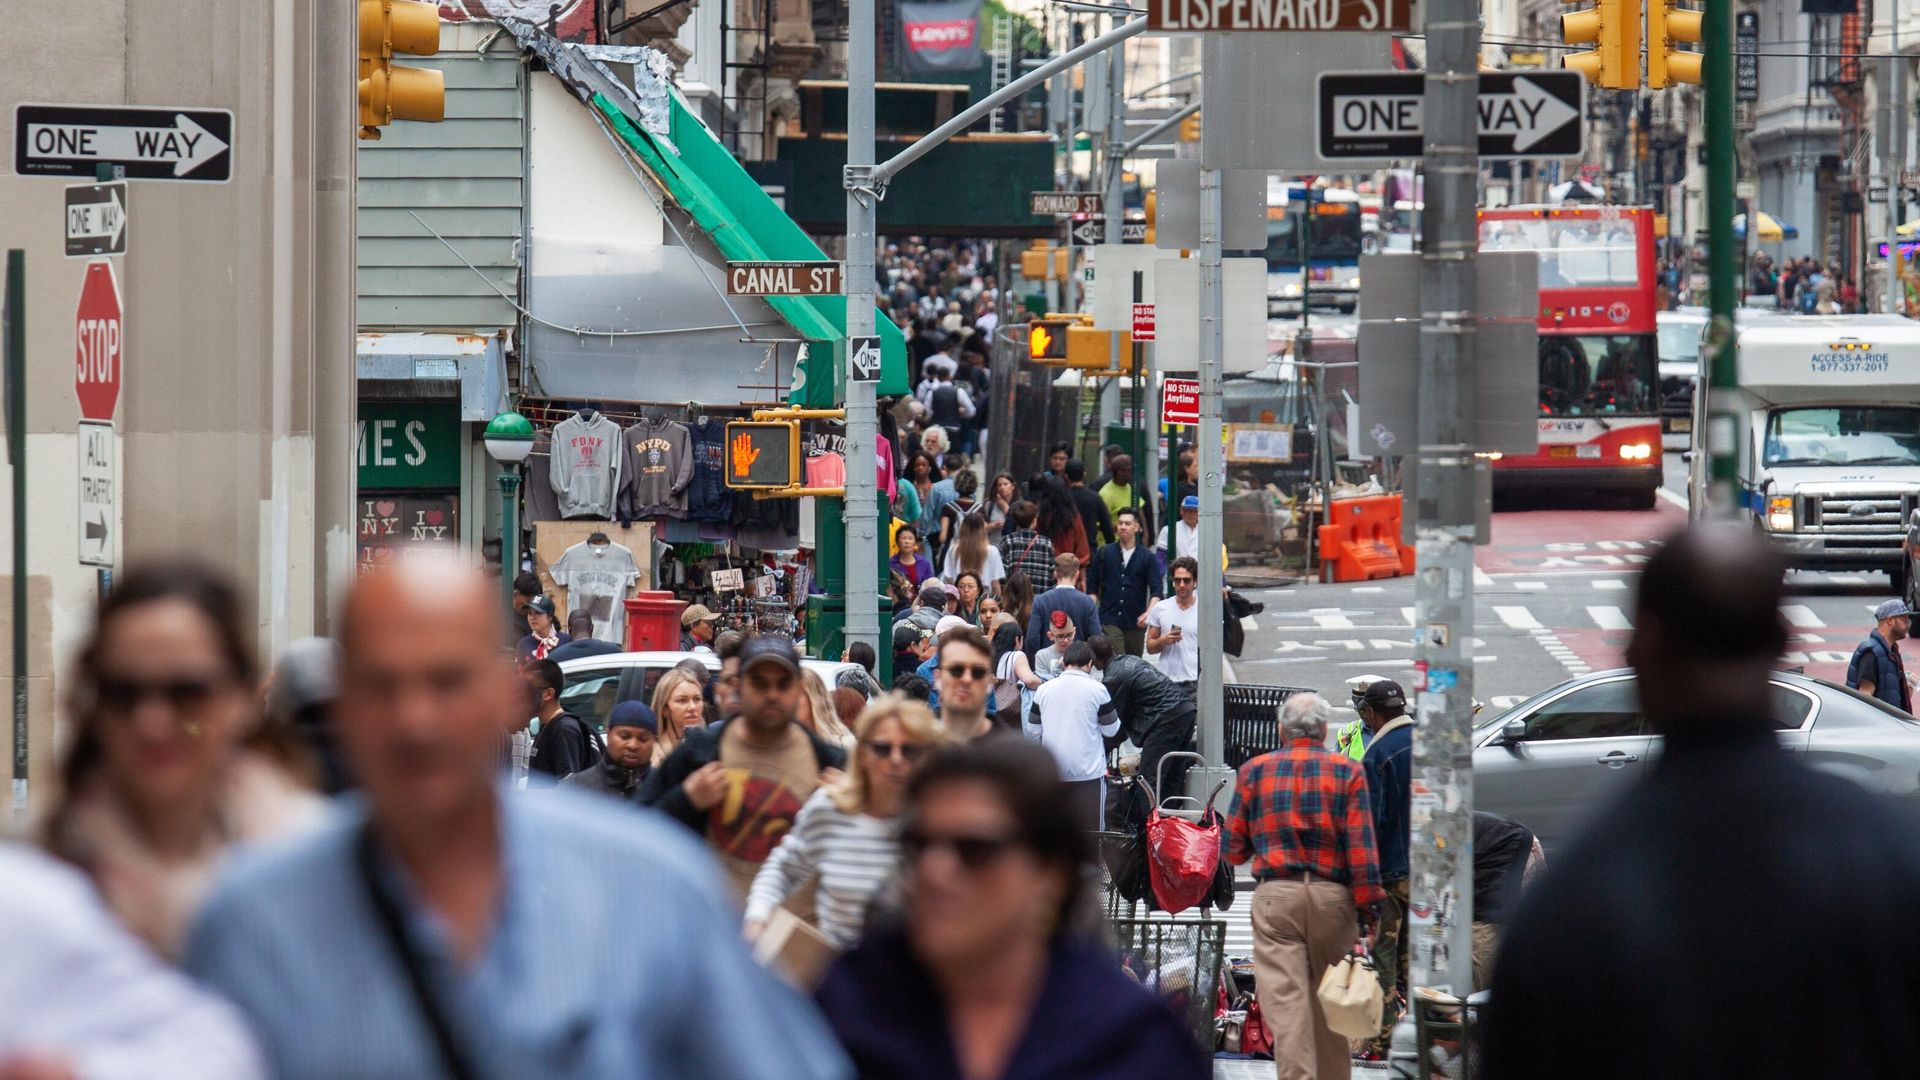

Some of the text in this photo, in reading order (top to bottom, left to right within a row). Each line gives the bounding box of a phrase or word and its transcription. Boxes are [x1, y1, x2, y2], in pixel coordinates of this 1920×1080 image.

[1161, 0, 1339, 30] LISPENARD
[1343, 100, 1419, 131] ONE
[35, 128, 203, 158] ONE WAY
[1033, 195, 1098, 212] HOWARD ST
[71, 204, 120, 234] ONE WAY
[732, 268, 835, 294] CANAL ST
[77, 319, 120, 383] STOP
[1811, 353, 1889, 362] ACCESS-A-RIDE
[860, 352, 879, 368] ONE
[1811, 363, 1889, 372] 1-877-337-2017
[1166, 384, 1200, 393] NO STAND
[1167, 394, 1195, 405] Anytime
[86, 432, 108, 467] ALL
[570, 436, 604, 448] FDNY
[635, 438, 672, 454] NYPD
[81, 477, 112, 505] TRAFFIC
[365, 501, 375, 517] I
[416, 510, 426, 525] I
[361, 518, 400, 535] NY
[411, 526, 448, 541] NY
